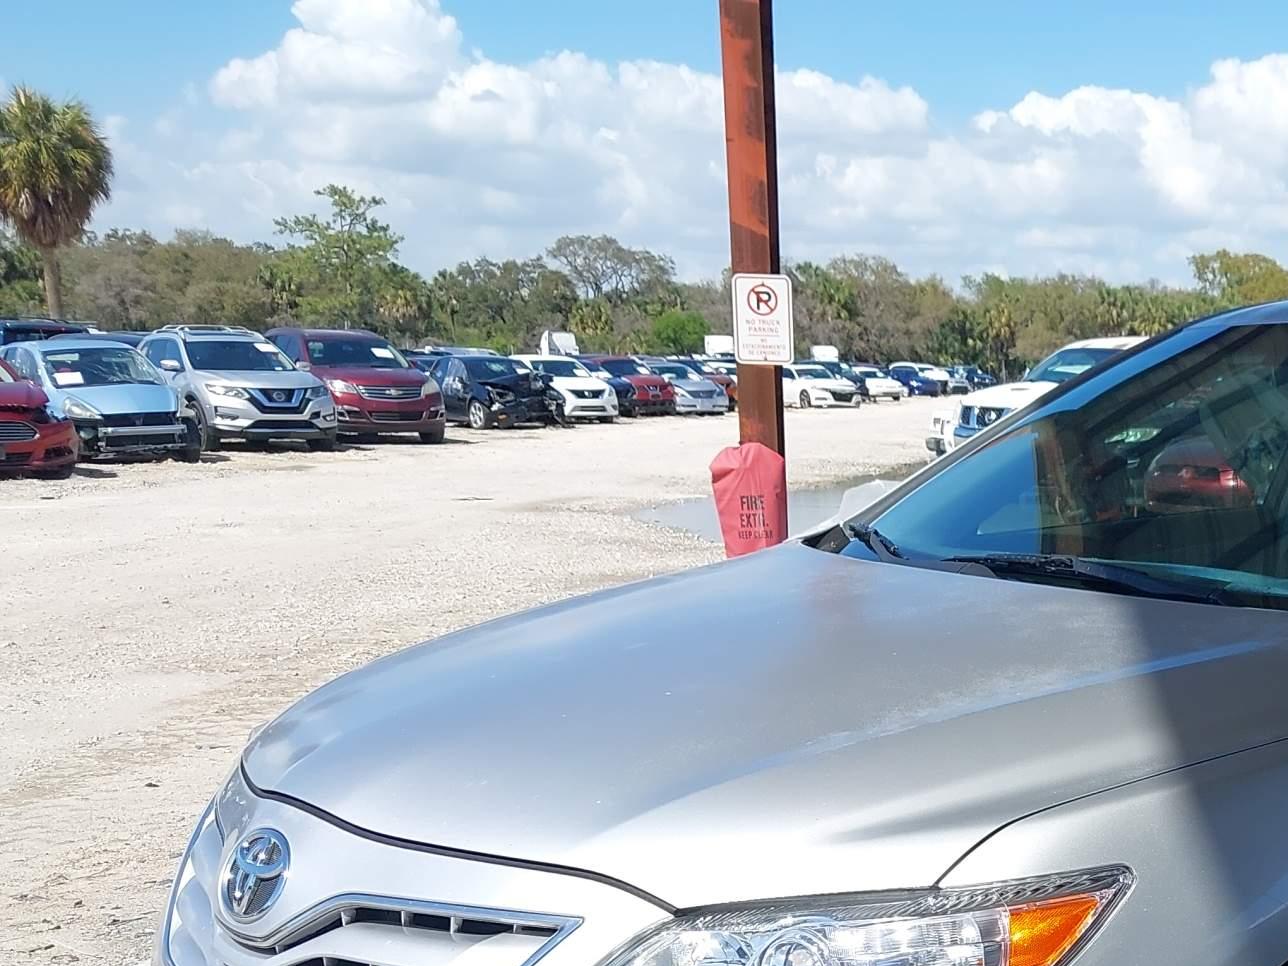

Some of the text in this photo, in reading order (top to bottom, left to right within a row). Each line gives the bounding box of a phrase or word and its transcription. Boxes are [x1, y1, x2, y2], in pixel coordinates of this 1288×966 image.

[748, 326, 779, 334] PARKING
[740, 495, 765, 511] FIRE
[738, 530, 752, 539] KEEP
